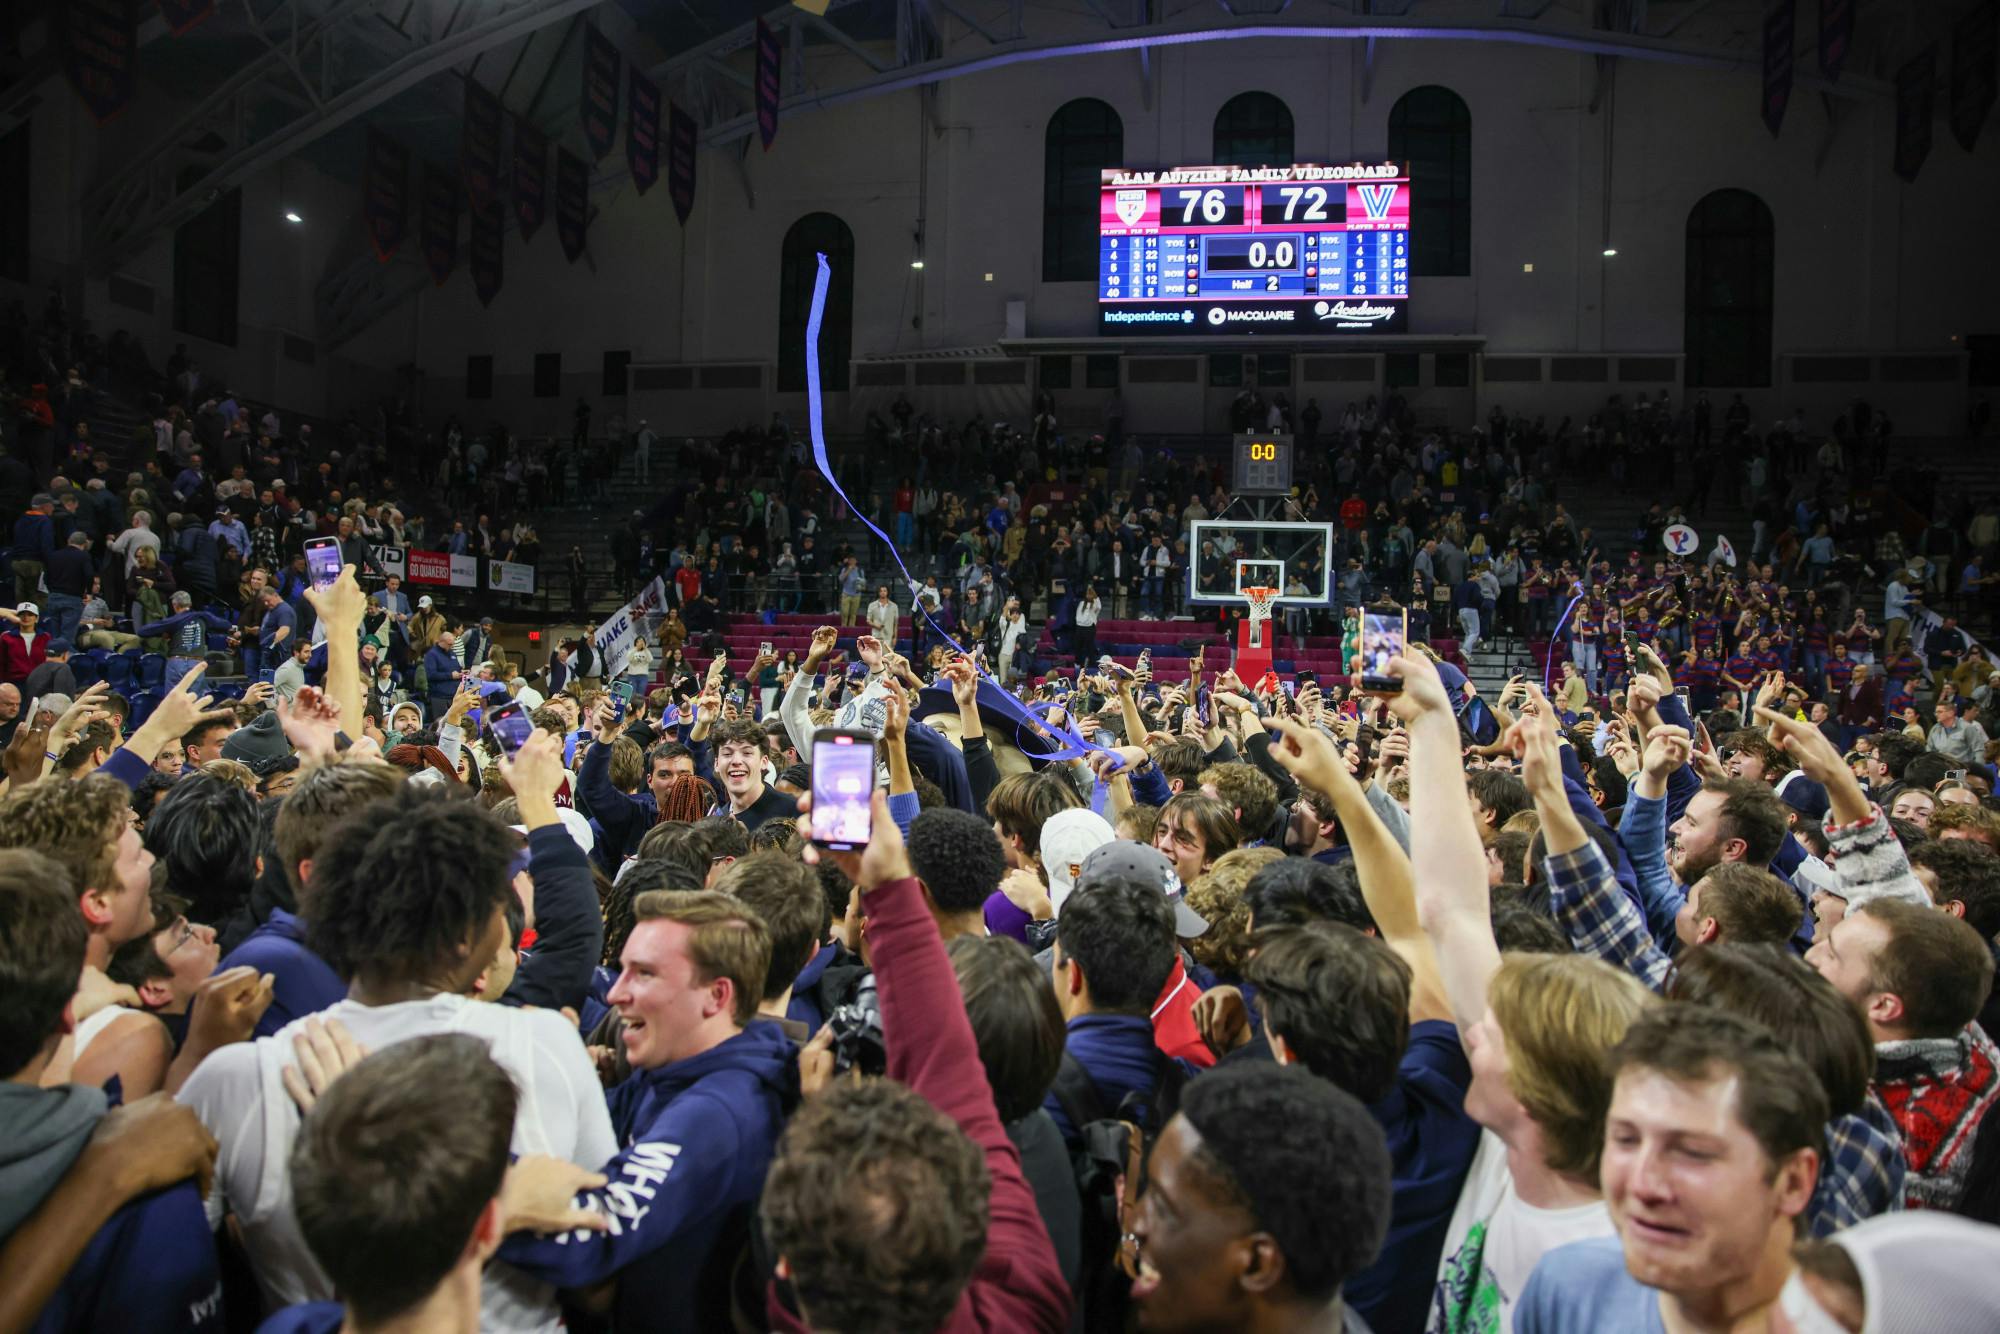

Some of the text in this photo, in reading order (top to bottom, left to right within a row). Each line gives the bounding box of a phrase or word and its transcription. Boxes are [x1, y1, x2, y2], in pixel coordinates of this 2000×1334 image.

[1112, 165, 1398, 185] ALAN AUFZIEN FAMILY VIDEOBOARD
[1179, 189, 1225, 223] 76
[1280, 186, 1327, 221] 72
[1356, 184, 1398, 221] V
[1110, 238, 1157, 248] 0 1 11
[1307, 236, 1340, 246] 0 TOL
[1356, 233, 1404, 243] 1 3 3
[1165, 239, 1195, 248] TOL 1
[1110, 251, 1118, 260] 4
[1145, 251, 1158, 260] 22
[1248, 241, 1294, 268] 0.0
[1355, 246, 1404, 256] 4 1 0
[1186, 254, 1198, 263] 10
[1305, 252, 1318, 261] 10
[1133, 263, 1140, 273] 2
[1146, 263, 1157, 273] 11
[1380, 259, 1388, 268] 3
[1393, 259, 1407, 268] 25
[1107, 276, 1158, 285] 10 4 12
[1353, 272, 1407, 281] 15 4 14
[1232, 276, 1278, 291] Half 2
[1106, 288, 1120, 297] 40
[1133, 288, 1140, 297] 2
[1352, 284, 1407, 294] 43 2 12
[1330, 300, 1395, 320] Academy
[1104, 310, 1180, 323] Independence
[1228, 310, 1295, 321] MACQUARIE
[1669, 530, 1689, 553] P
[410, 563, 419, 577] GO
[420, 564, 449, 580] QUAKERS!
